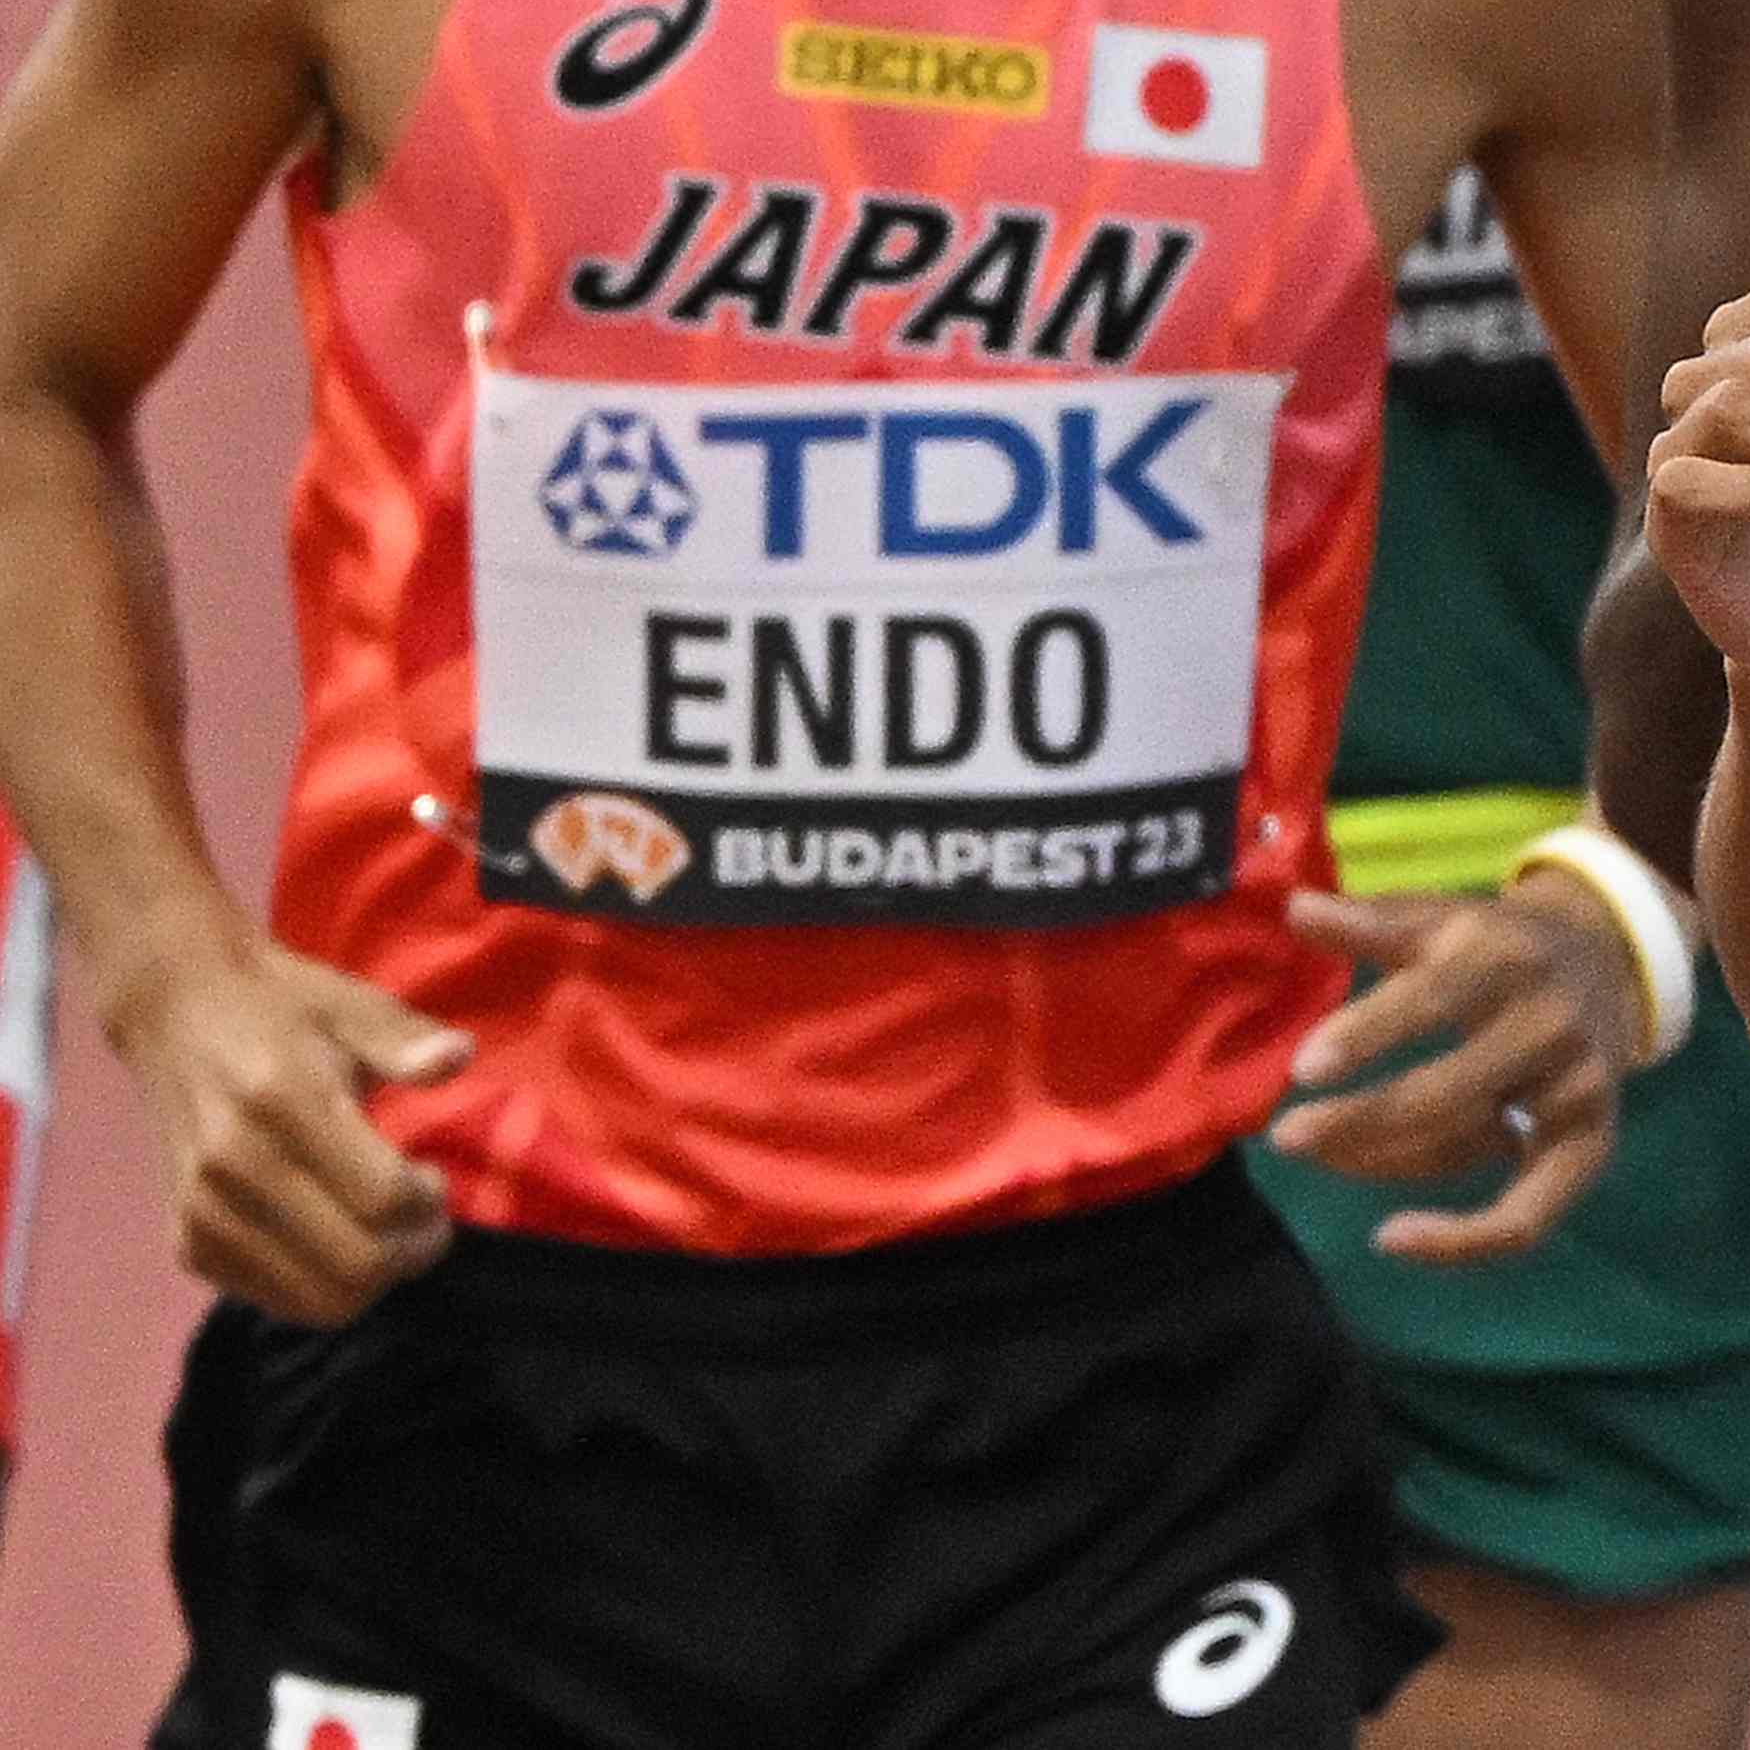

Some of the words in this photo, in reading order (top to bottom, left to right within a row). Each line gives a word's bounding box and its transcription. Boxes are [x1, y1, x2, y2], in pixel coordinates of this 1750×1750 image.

[788, 42, 1040, 104] SEIKO
[567, 178, 1198, 368] JAPAN
[698, 398, 1212, 560] TDK
[645, 605, 1108, 770] ENDO
[713, 820, 1127, 890] BUDAPEST
[1132, 808, 1203, 878] 23
